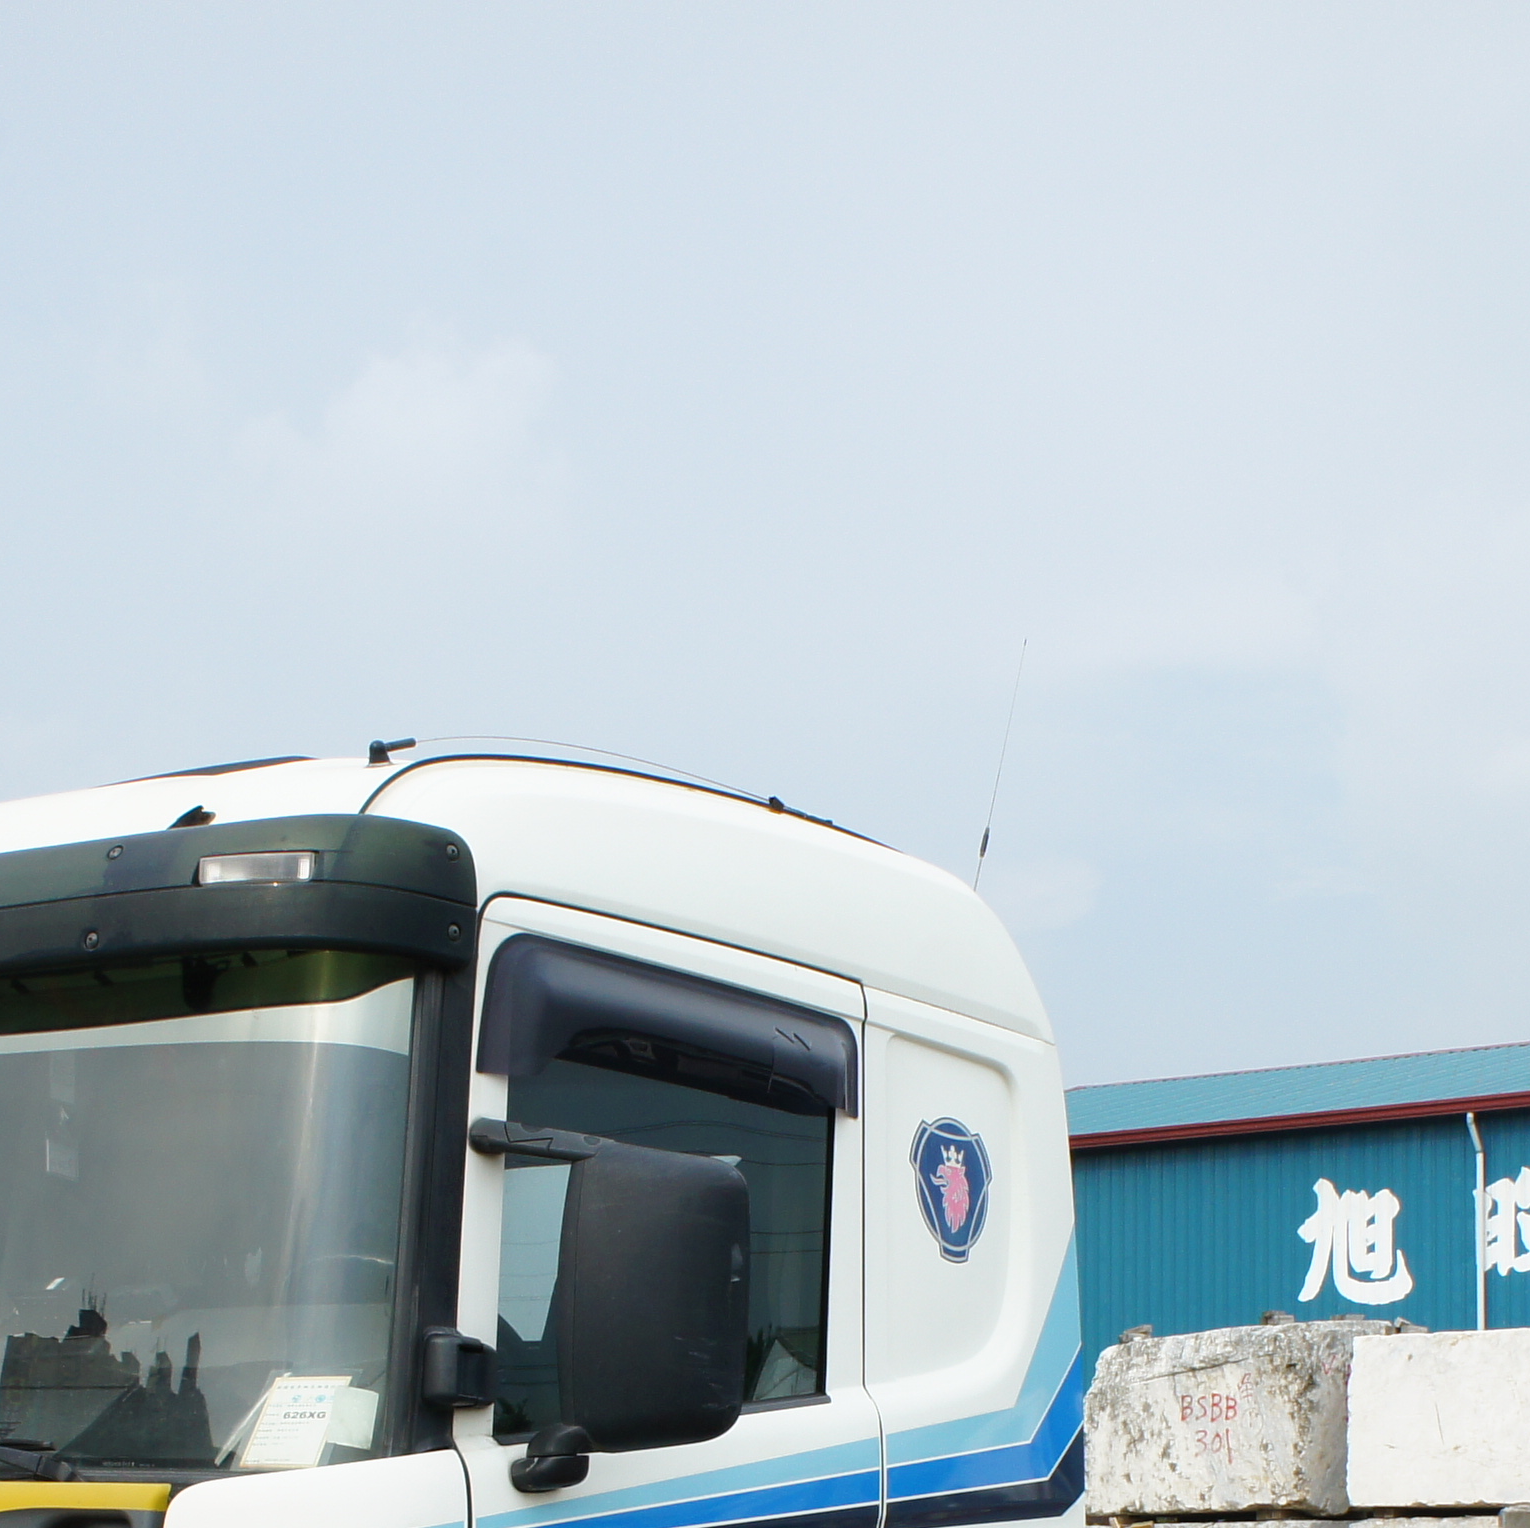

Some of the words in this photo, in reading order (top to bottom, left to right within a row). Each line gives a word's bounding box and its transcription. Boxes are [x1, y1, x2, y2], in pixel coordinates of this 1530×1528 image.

[283, 1411, 327, 1419] 626XG
[1180, 1392, 1239, 1423] BSBB
[1195, 1428, 1234, 1465] 301
